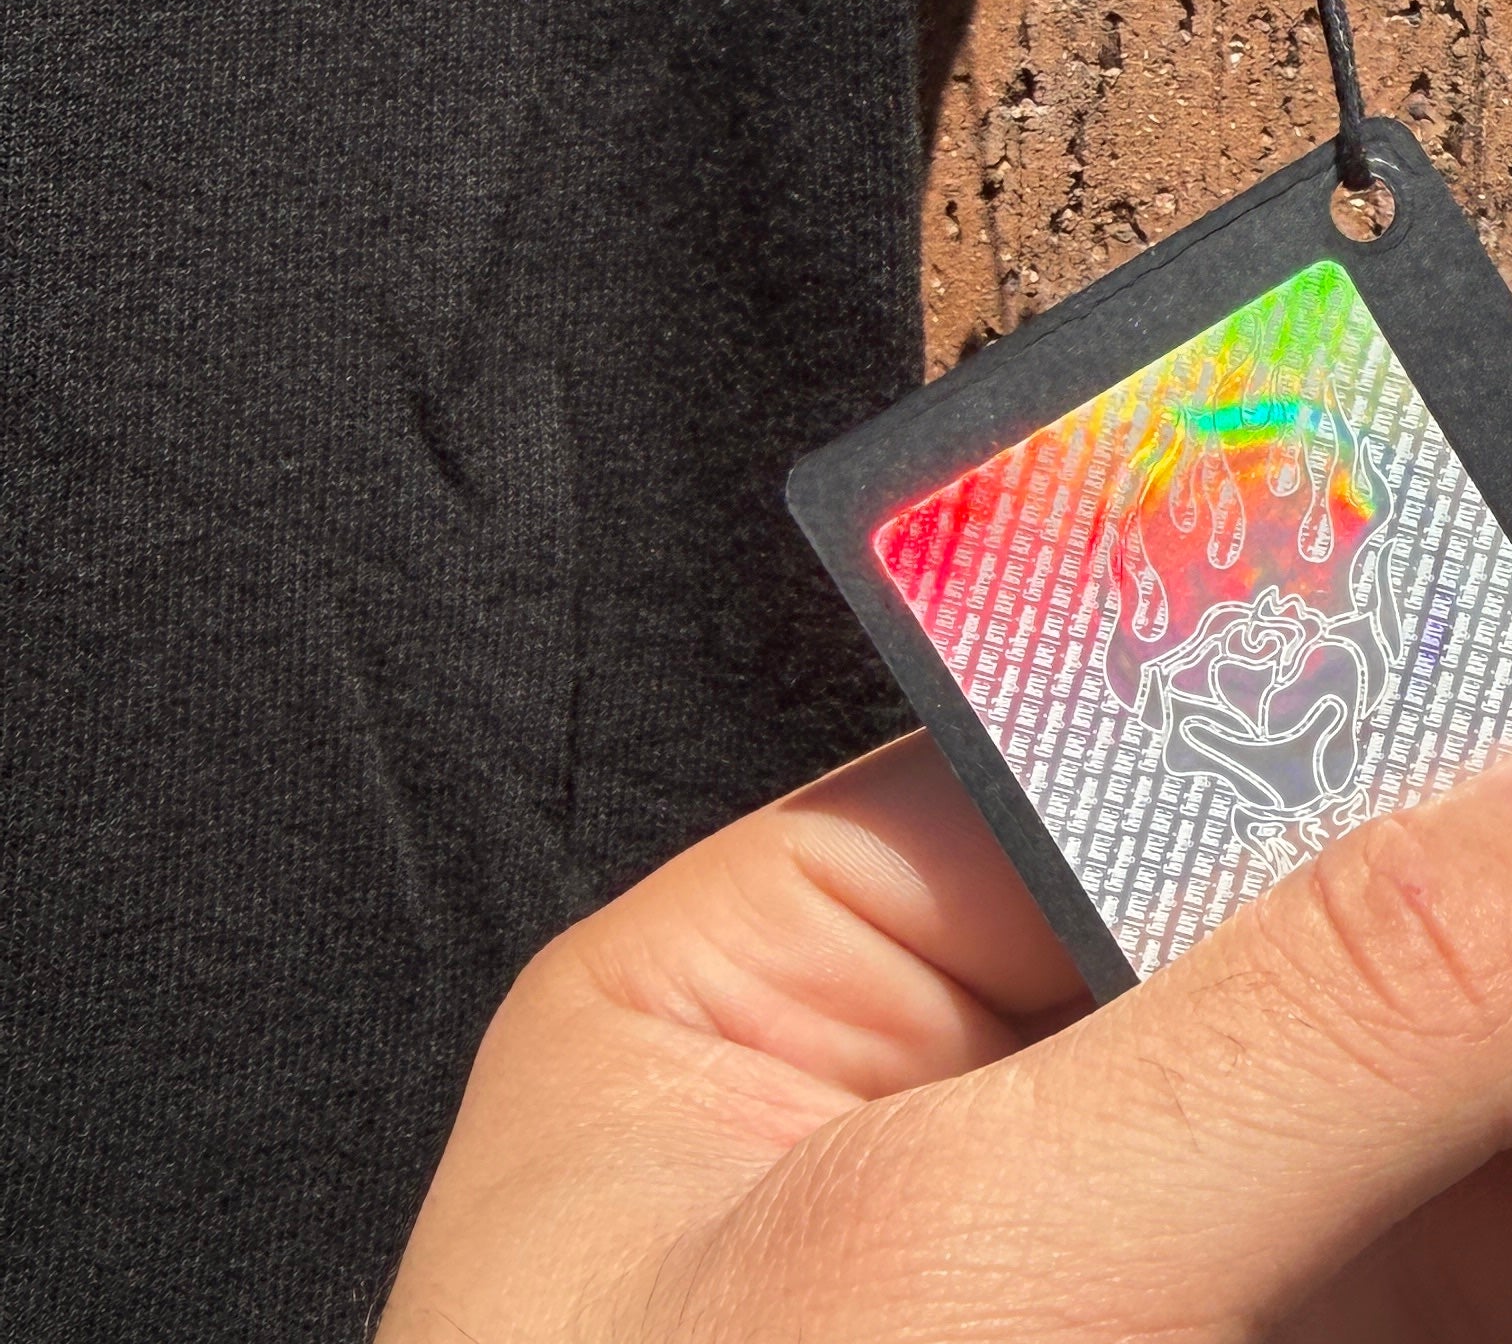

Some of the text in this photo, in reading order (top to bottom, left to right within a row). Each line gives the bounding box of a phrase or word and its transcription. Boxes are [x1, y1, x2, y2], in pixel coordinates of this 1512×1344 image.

[1405, 473, 1431, 501] RFC
[974, 648, 999, 675] RFC
[983, 618, 1008, 645] BTC
[986, 664, 1020, 722] Civilregime
[1004, 603, 1037, 662] Civilregime
[1031, 642, 1056, 669] RFC
[1040, 612, 1064, 639] BTC
[1352, 731, 1385, 789] Civilregime
[1402, 553, 1435, 610] Civilregime
[1419, 493, 1452, 551] Civilregime
[1378, 768, 1404, 795] RFC
[1394, 709, 1420, 736] RFC
[1411, 651, 1436, 678] RFC
[1427, 592, 1452, 619] RFC
[1444, 534, 1469, 561] RFC
[1422, 670, 1454, 728] Civilregime
[1438, 611, 1471, 668] Civilregime
[1455, 552, 1488, 609] Civilregime
[1448, 708, 1472, 735] RFC
[1464, 650, 1489, 677] RFC
[1480, 591, 1505, 618] RFC
[1014, 701, 1040, 728] RFC
[1023, 672, 1048, 698] BTC
[1032, 700, 1066, 758] Civilregime
[1049, 640, 1083, 698] Civilregime
[1480, 656, 1512, 714] Civilregime
[1044, 790, 1070, 818] RFC
[1061, 732, 1087, 759] RFC
[1065, 716, 1115, 834] Civilregime Civilregime
[1094, 807, 1120, 834] RFC
[1111, 748, 1136, 775] RFC
[1120, 775, 1153, 833] Civilregime
[1132, 865, 1157, 892] RFC
[1148, 807, 1174, 834] RFC
[1144, 818, 1195, 937] Civilregime Civilregime
[1174, 909, 1199, 936] RFC
[1190, 851, 1216, 878] RFC
[1207, 793, 1232, 820] RFC
